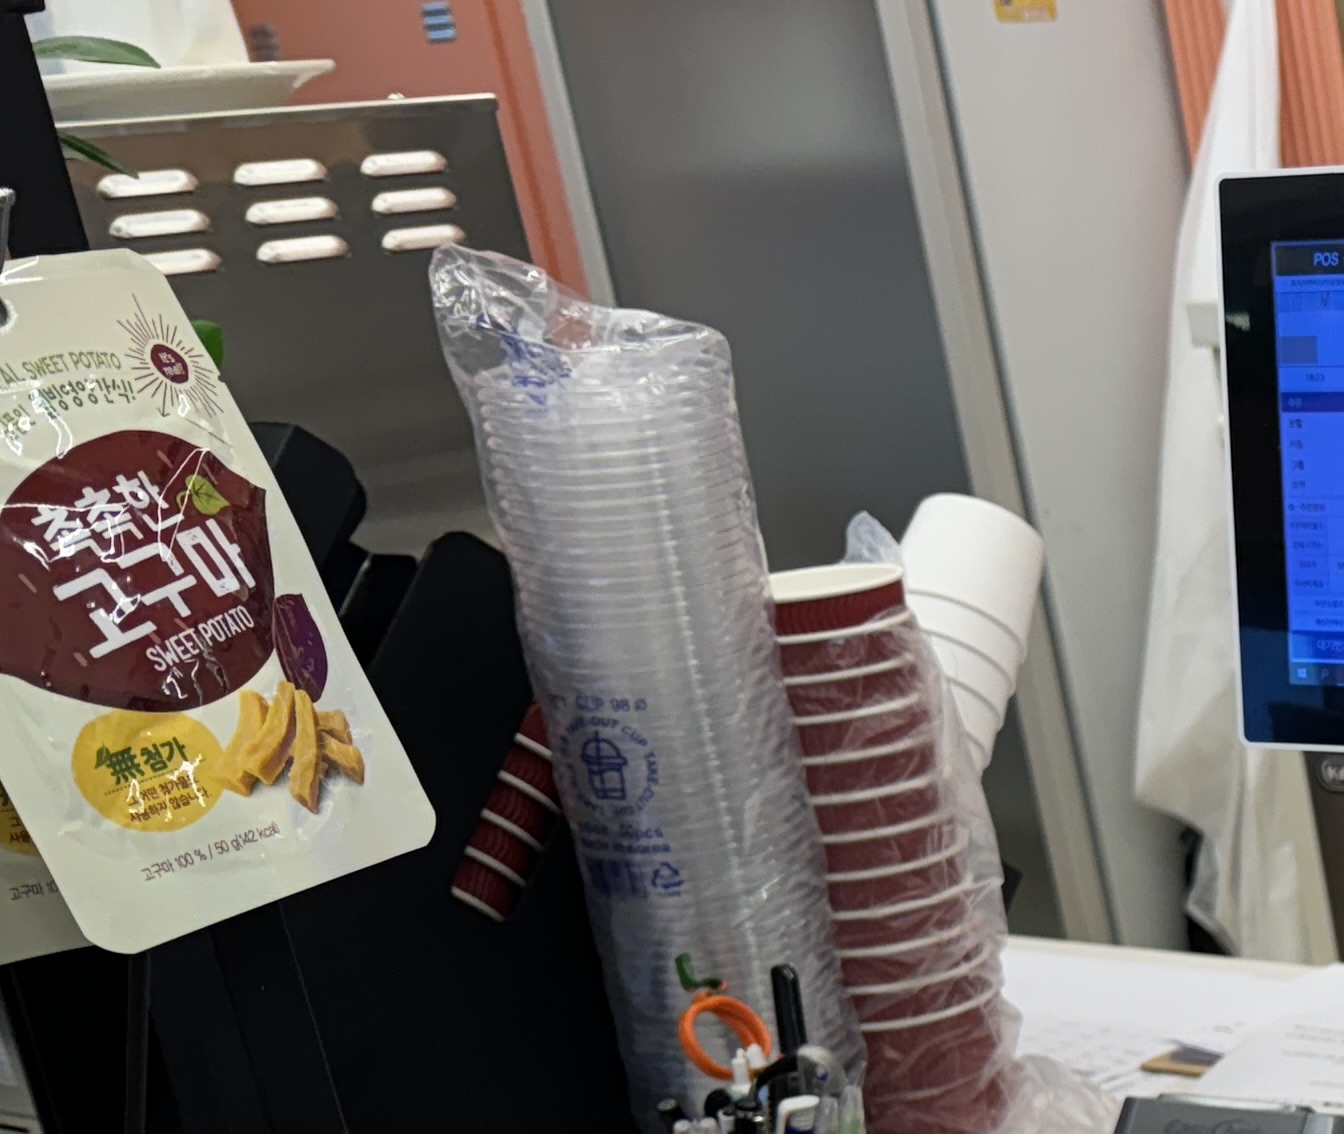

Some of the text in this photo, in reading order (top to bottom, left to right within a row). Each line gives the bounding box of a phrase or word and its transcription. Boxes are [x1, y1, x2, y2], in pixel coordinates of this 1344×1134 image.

[1313, 251, 1339, 266] POS
[22, 352, 121, 380] SWEET POTATO
[53, 518, 256, 659] 고구마
[146, 605, 254, 673] SWEET POTATO
[141, 860, 174, 881] 고구마
